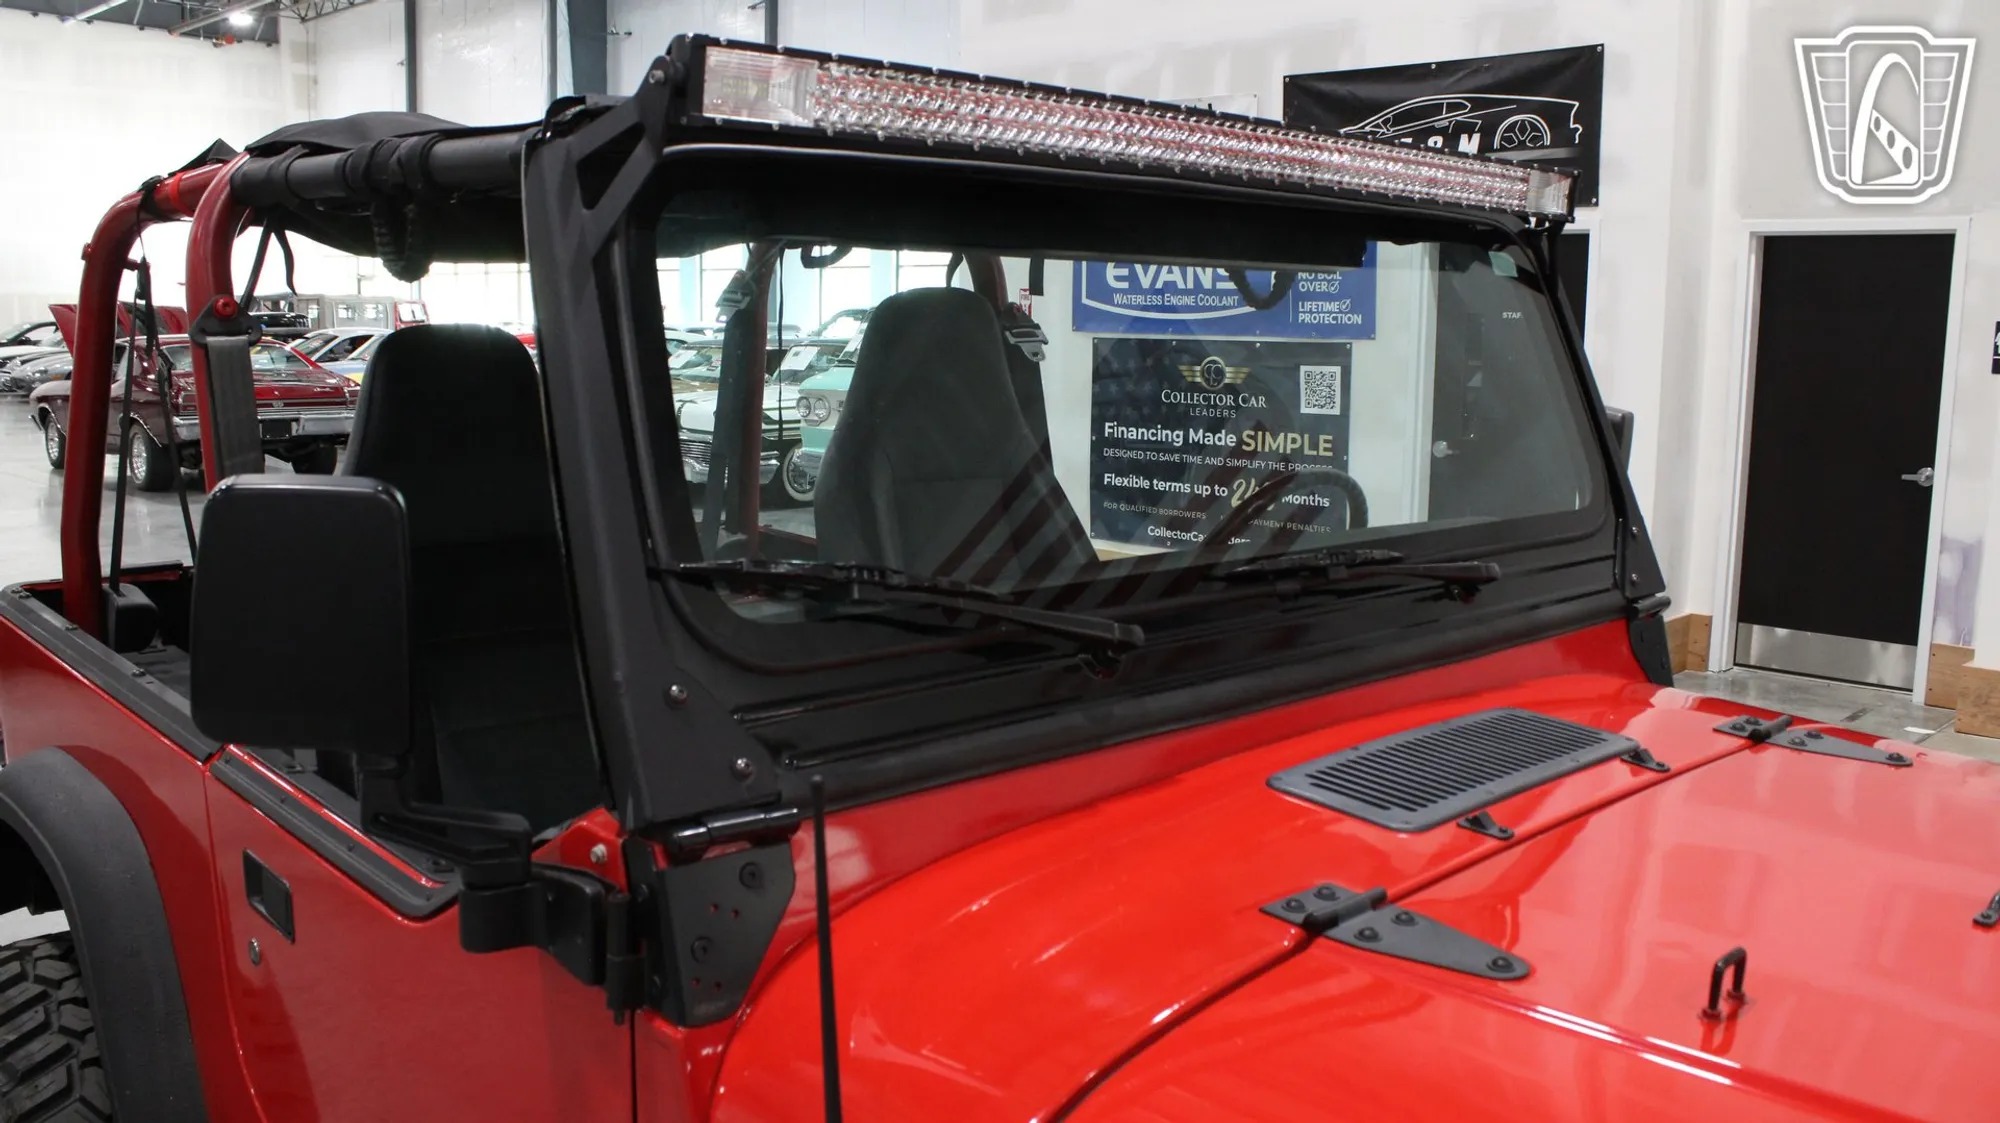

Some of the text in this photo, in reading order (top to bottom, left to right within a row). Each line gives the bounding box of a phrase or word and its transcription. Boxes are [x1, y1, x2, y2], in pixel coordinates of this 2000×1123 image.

[1298, 281, 1328, 292] OVER
[1113, 293, 1239, 306] WATERLESS ENGINE COOLANT
[1298, 301, 1340, 312] LIFETIME
[1298, 313, 1362, 324] PROTECTION
[1501, 311, 1523, 319] STAF
[1161, 389, 1267, 408] COLLECTOR CAR
[1189, 407, 1237, 418] LEADERS
[1104, 421, 1334, 457] Financing Made SIMPLE
[1103, 447, 1144, 460] DESIGNED
[1145, 451, 1158, 460] TO
[1159, 452, 1181, 463] SAVE
[1182, 454, 1203, 464] TIME
[1204, 456, 1224, 466] AND
[1225, 458, 1266, 470] SIMPLIFY
[1267, 461, 1286, 471] THE
[1103, 473, 1151, 489] Flexible
[1152, 478, 1191, 493] terms
[1193, 484, 1212, 498] up
[1213, 484, 1228, 497] to
[1281, 493, 1331, 508] Months
[1103, 501, 1118, 510] FOR
[1119, 503, 1158, 514] QUALIFIED
[1158, 507, 1207, 520] BORROWERS
[1286, 522, 1332, 534] PENALTIES
